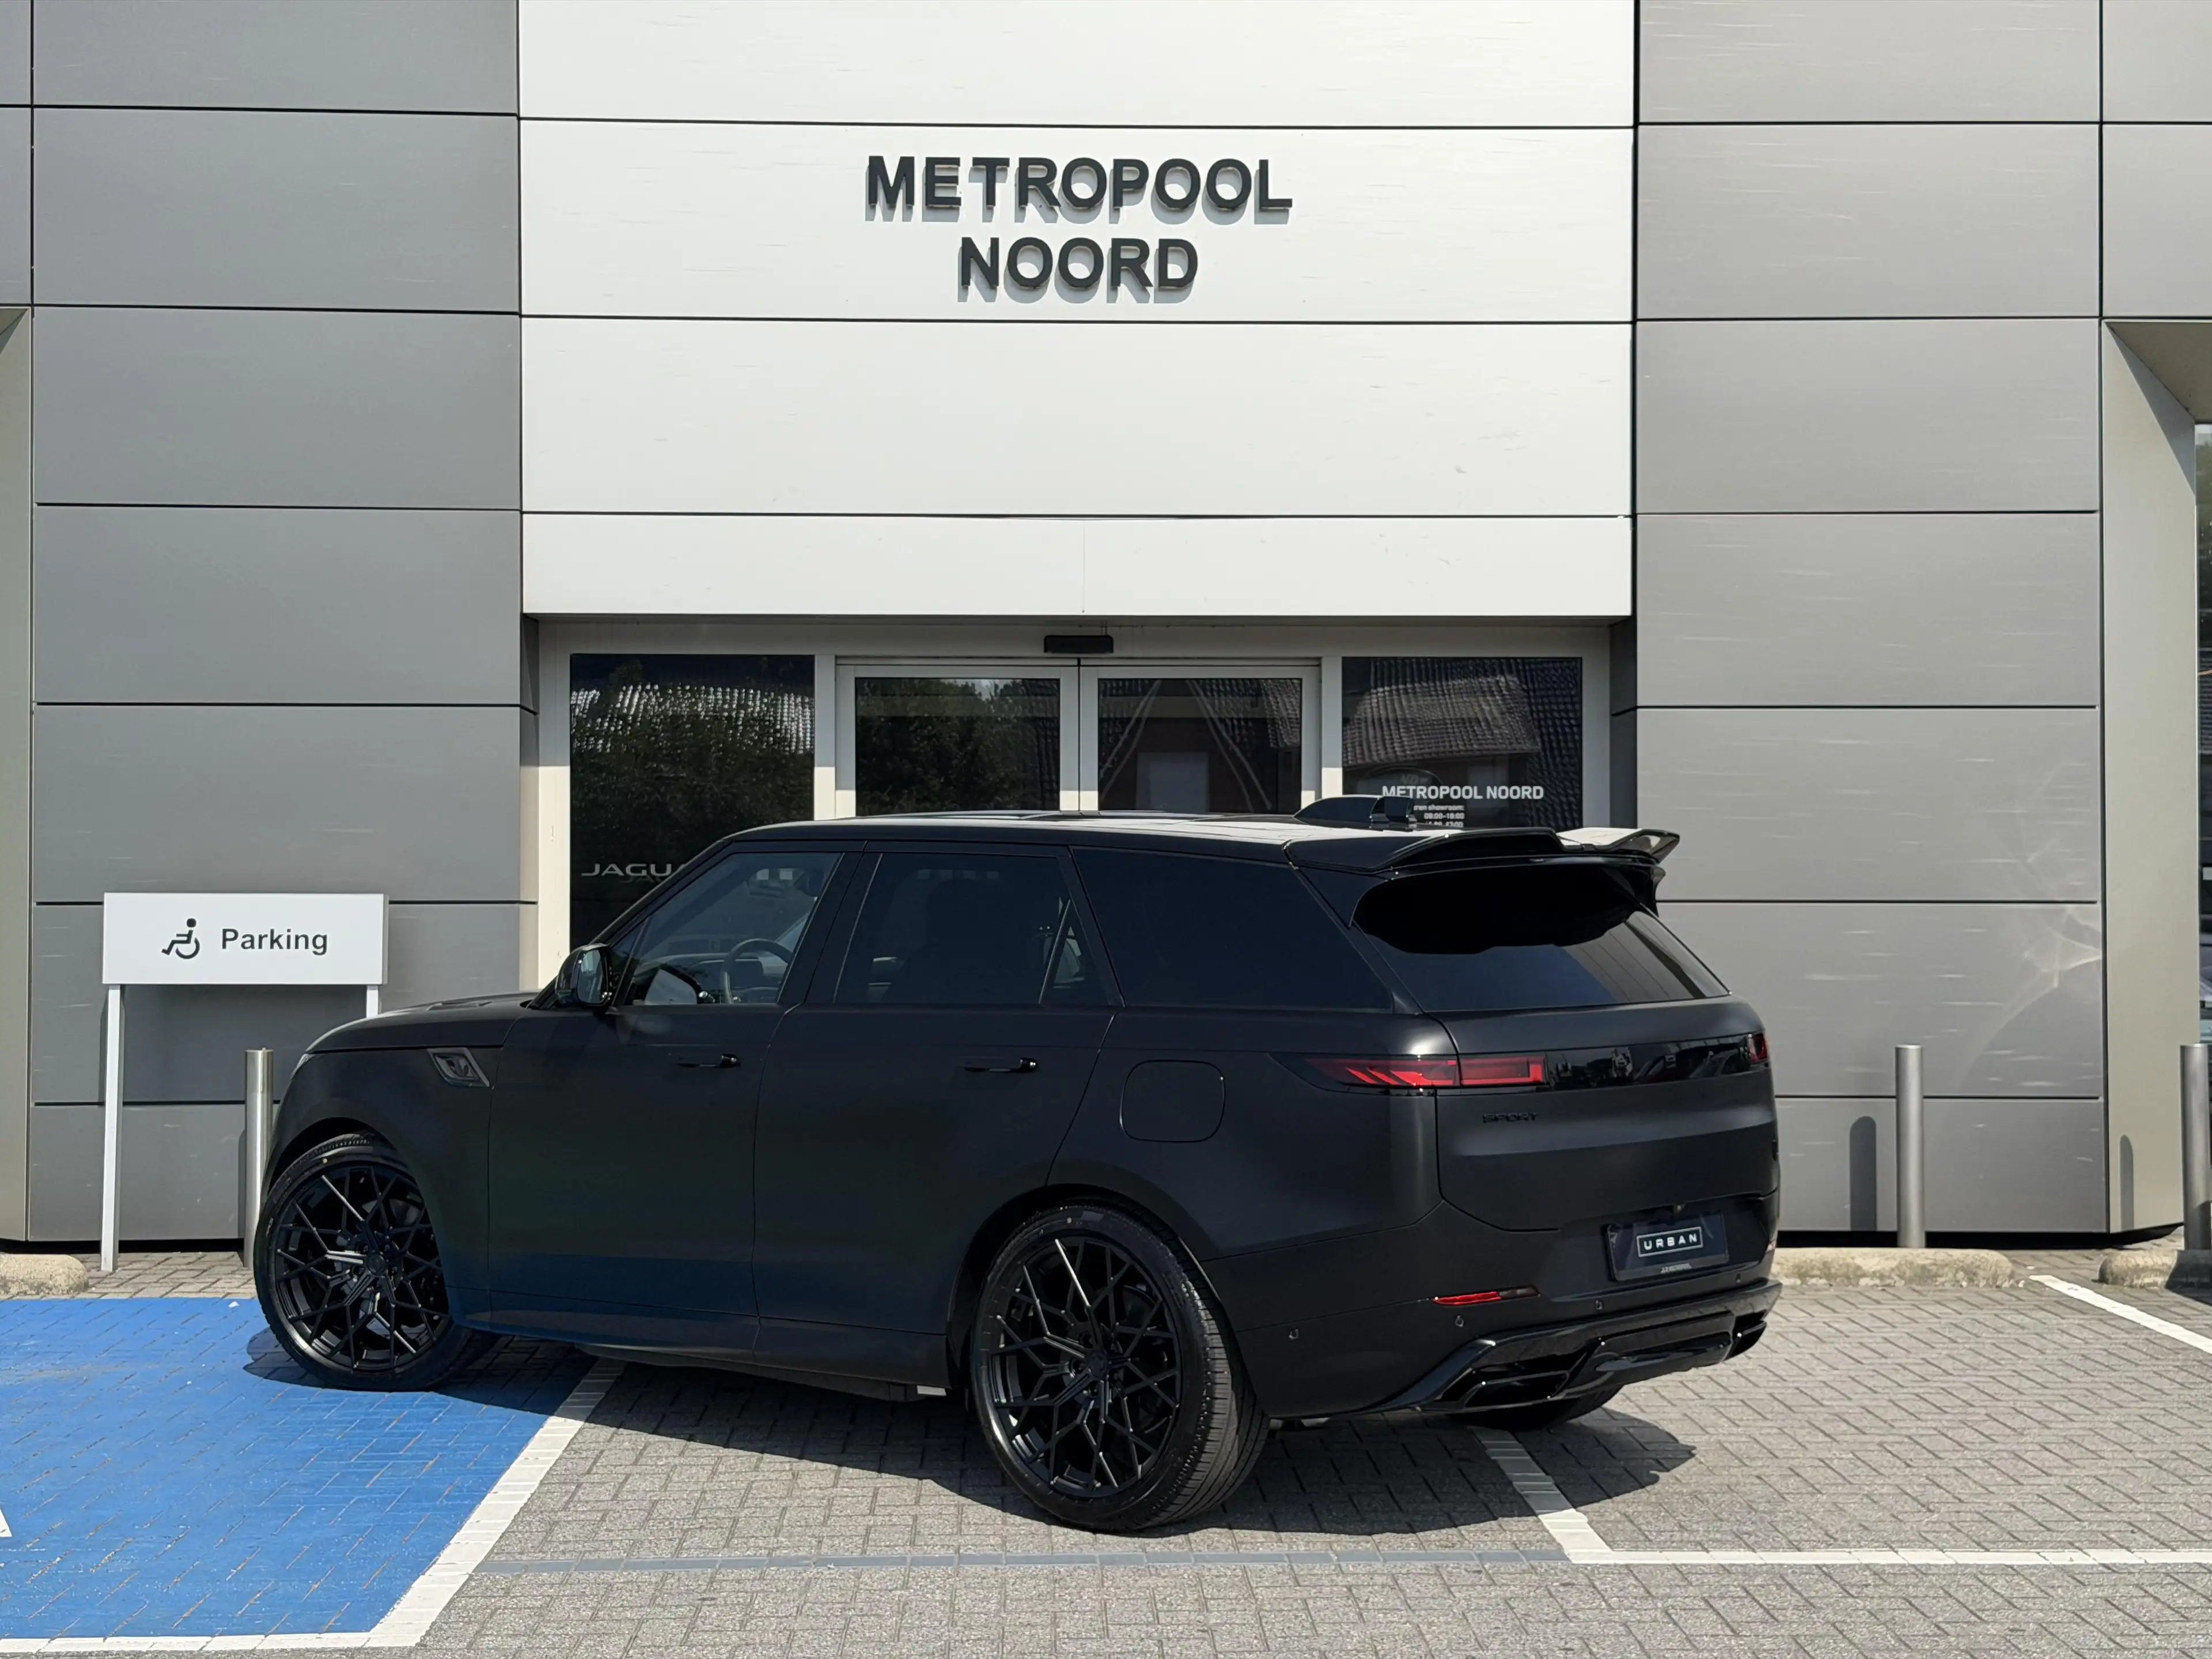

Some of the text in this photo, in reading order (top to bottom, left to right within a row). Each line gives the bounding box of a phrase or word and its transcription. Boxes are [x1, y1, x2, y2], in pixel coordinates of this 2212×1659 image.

[868, 154, 1293, 214] METROPOOL
[961, 236, 1199, 290] NOORD
[1382, 786, 1544, 800] METROPOOL NOORD
[581, 863, 676, 877] JAGU
[221, 927, 328, 956] Parking
[1643, 1233, 1698, 1251] URBAN
